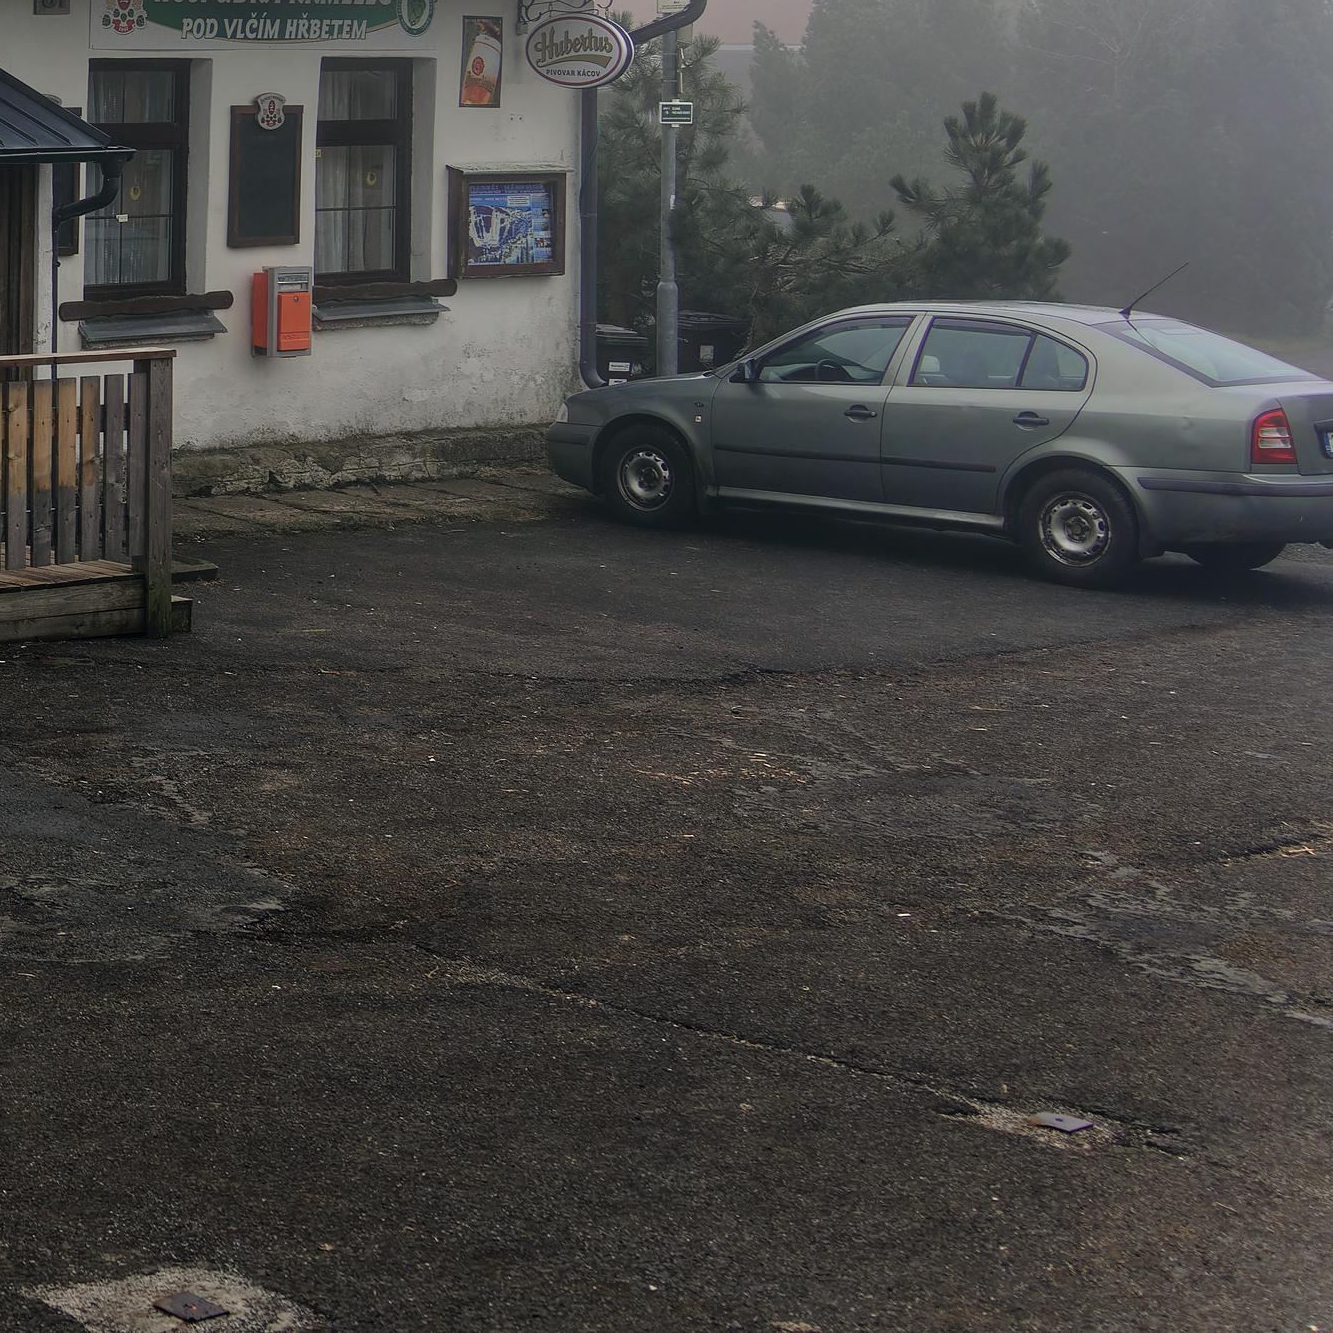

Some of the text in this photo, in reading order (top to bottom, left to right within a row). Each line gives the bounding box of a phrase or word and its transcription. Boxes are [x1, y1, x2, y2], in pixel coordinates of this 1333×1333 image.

[181, 12, 368, 40] POD VLČÍM HŘBETEM
[533, 27, 613, 64] Hubertus
[545, 67, 601, 78] PIVOVAR KÁCOV
